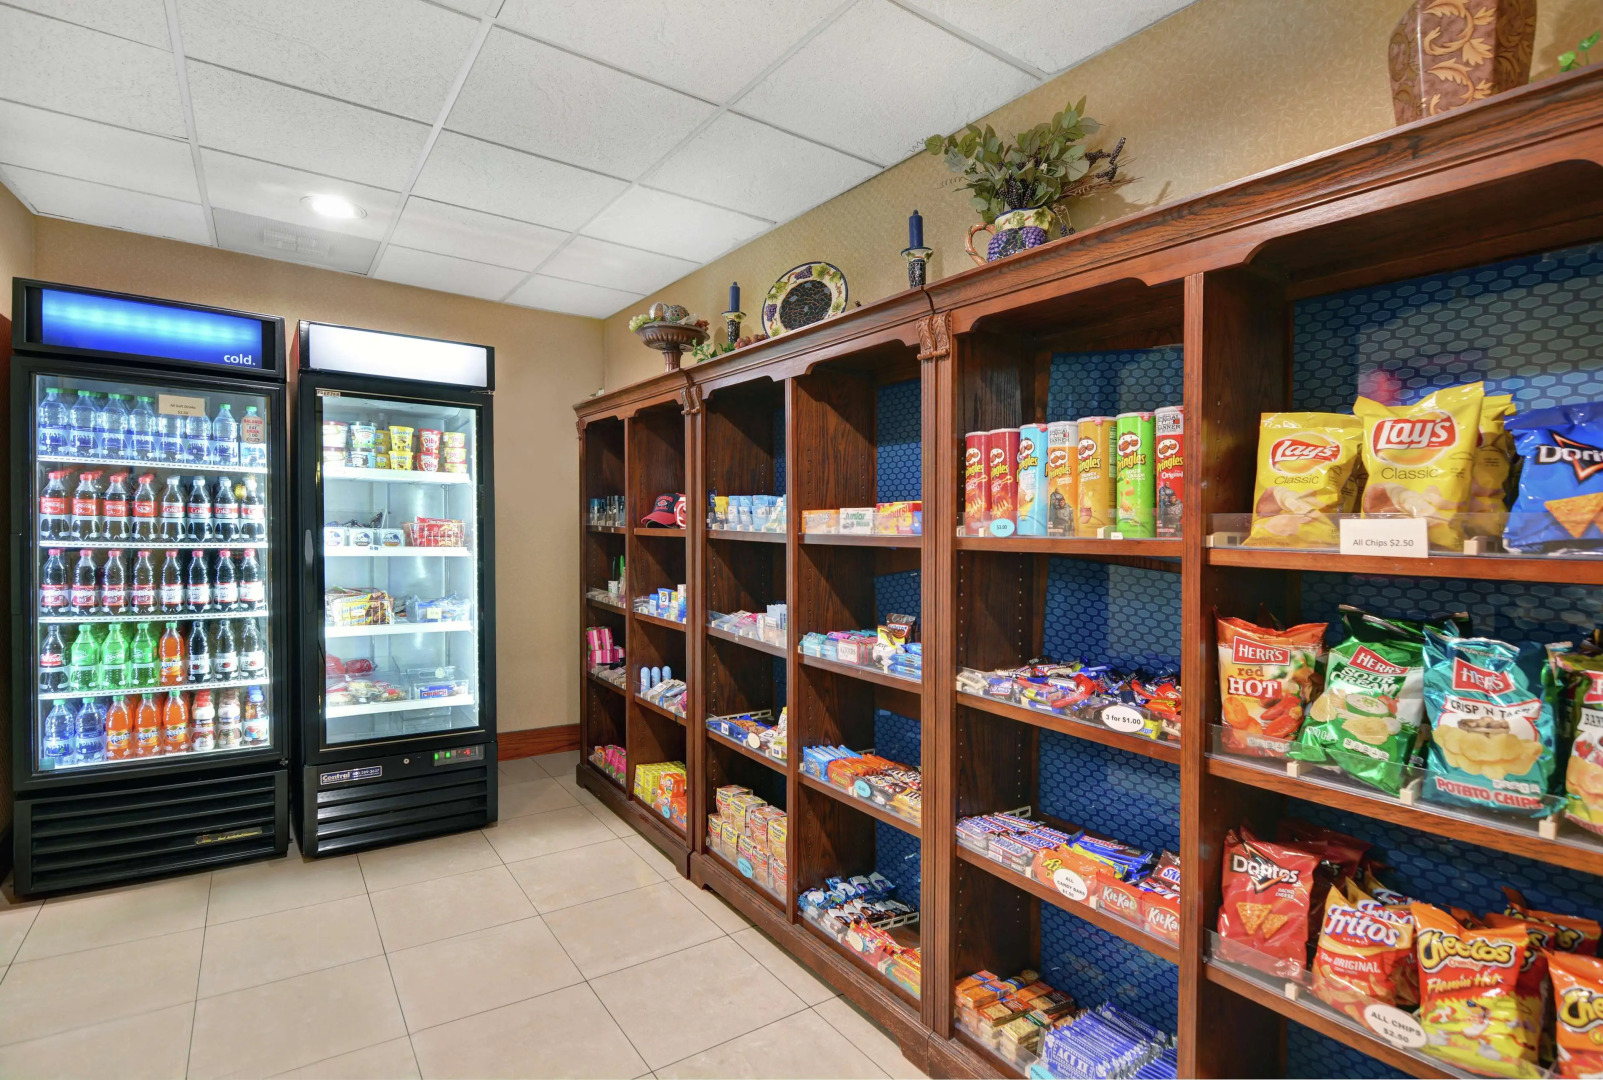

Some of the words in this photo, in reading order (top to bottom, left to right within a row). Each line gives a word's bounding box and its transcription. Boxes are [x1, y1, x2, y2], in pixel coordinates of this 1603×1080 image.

[224, 354, 256, 365] cold.
[1376, 418, 1452, 450] Lay's
[1275, 440, 1337, 462] Lay's
[1274, 475, 1320, 485] Classic
[1381, 467, 1440, 480] Classic
[845, 512, 866, 520] Junior
[1353, 539, 1363, 547] All
[1365, 539, 1387, 547] Chips
[1390, 539, 1414, 547] $2.50
[1239, 644, 1283, 662] HERR'S
[1237, 666, 1265, 677] red
[1356, 652, 1402, 674] HERR'S
[1330, 671, 1400, 696] CREAM
[1344, 667, 1396, 684] SOUR
[1228, 677, 1278, 698] HOT
[1451, 701, 1479, 714] CRISP
[1122, 716, 1141, 725] $1.00
[322, 772, 351, 781] Central
[1435, 777, 1491, 800] POTATO
[1493, 792, 1544, 809] CHIPS
[1233, 855, 1299, 883] Doritos
[1057, 880, 1072, 890] CANDY
[1073, 888, 1086, 896] BARS
[1324, 904, 1401, 947] Fritos
[1418, 930, 1513, 969] Cheetos
[1333, 957, 1381, 974] ORIGINAL
[1475, 973, 1502, 987] Hot
[1371, 1011, 1389, 1023] ALL
[1391, 1020, 1422, 1036] CHIPS
[1383, 1027, 1410, 1043] $2.50
[1056, 1047, 1076, 1066] ACT
